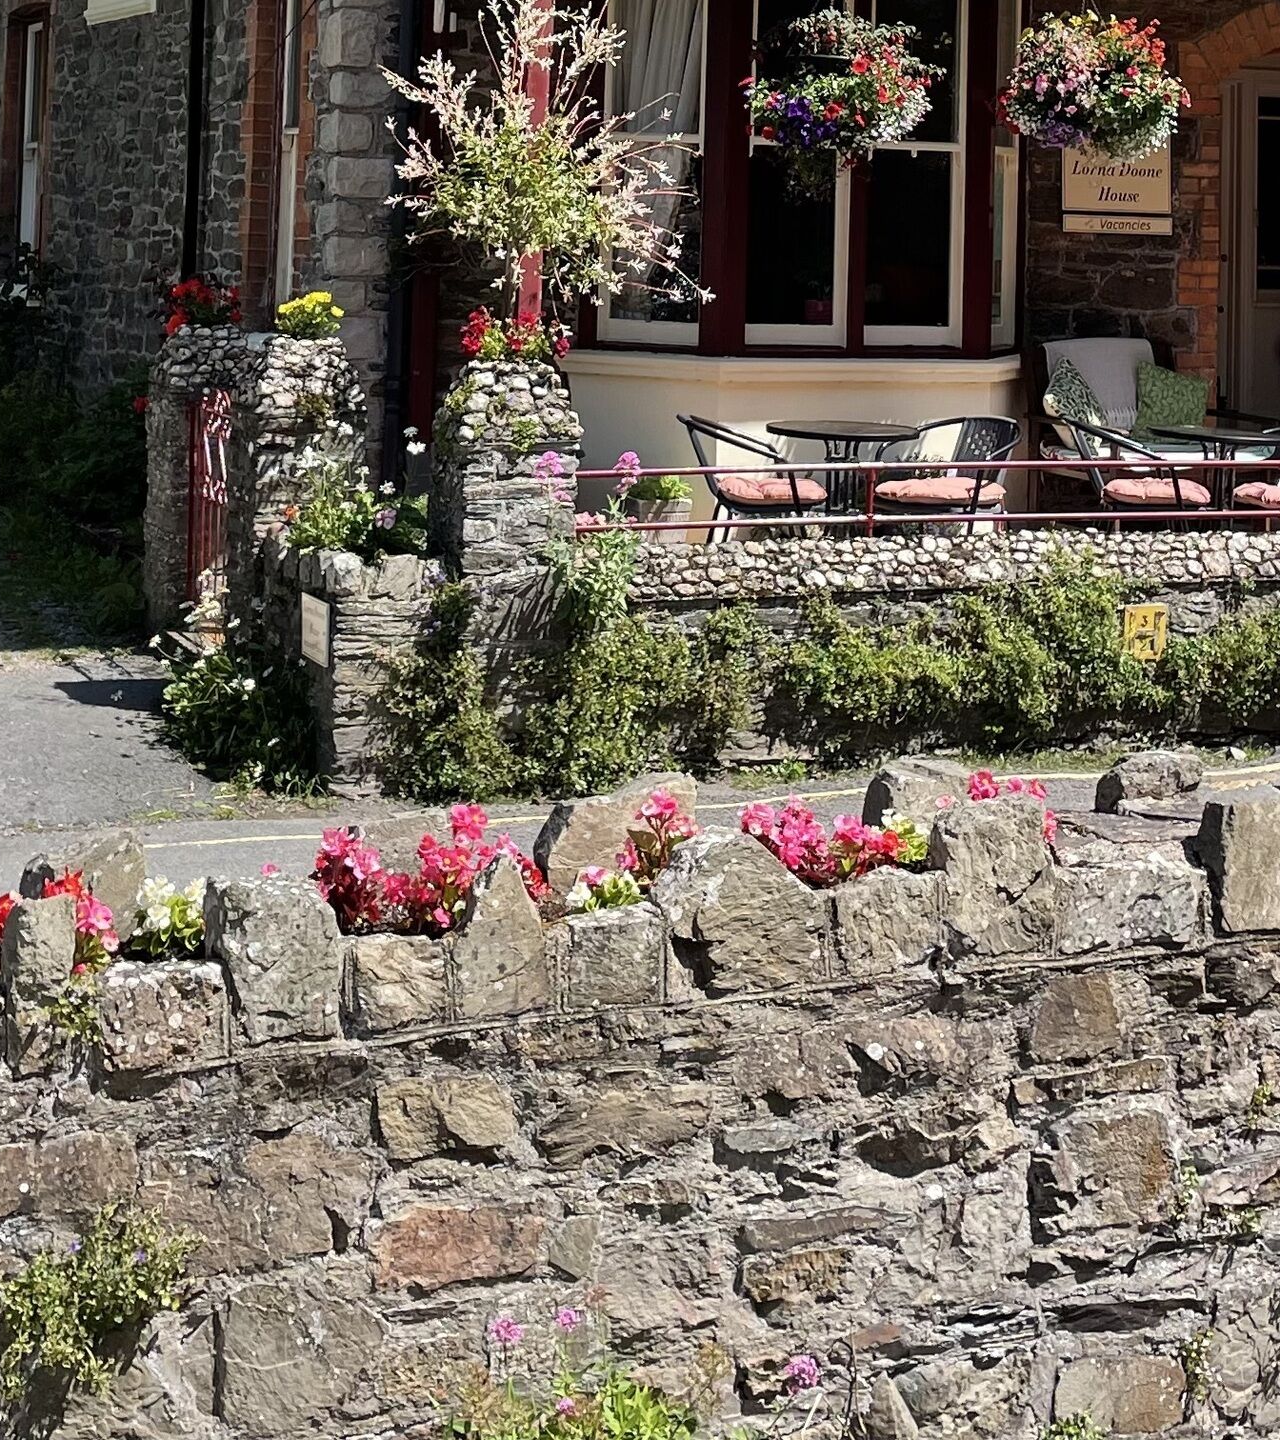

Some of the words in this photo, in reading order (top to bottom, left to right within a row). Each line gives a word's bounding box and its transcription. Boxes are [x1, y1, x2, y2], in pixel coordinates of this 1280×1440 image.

[1071, 160, 1116, 177] Lorna
[1118, 162, 1163, 178] Doone
[1098, 186, 1140, 202] House
[1100, 219, 1152, 231] Vacancies
